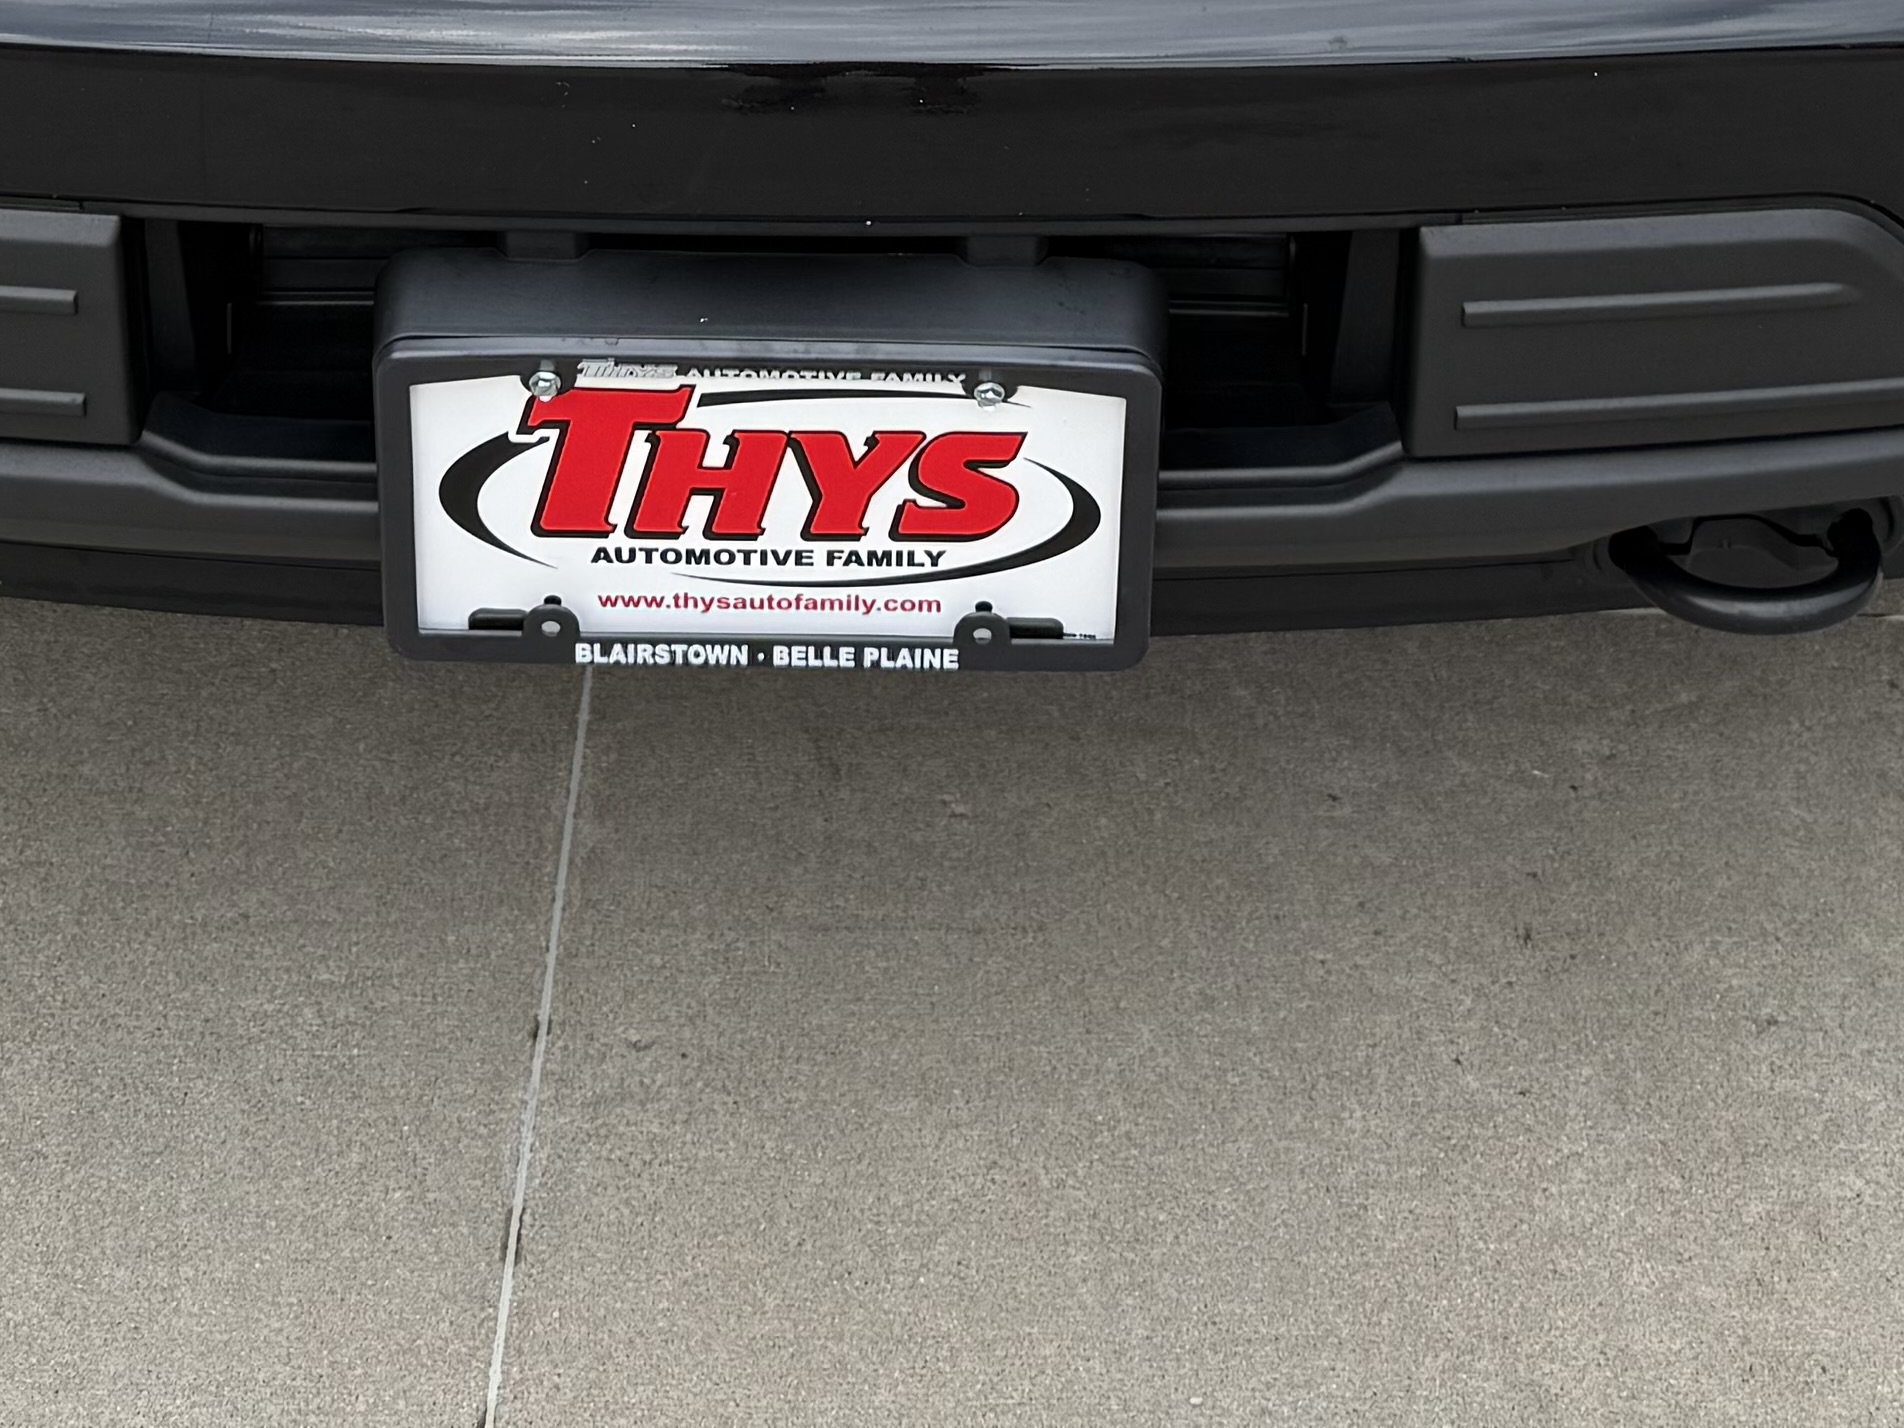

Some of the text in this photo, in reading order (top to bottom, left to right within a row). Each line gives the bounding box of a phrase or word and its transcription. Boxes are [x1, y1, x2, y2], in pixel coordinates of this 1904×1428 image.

[514, 384, 1029, 543] THYS
[590, 546, 948, 568] AUTOMOTIVE FAMILY
[597, 591, 942, 615] www.thysautofamily.com
[574, 642, 960, 671] BLAIRSTOWN BELLE PLAINE
